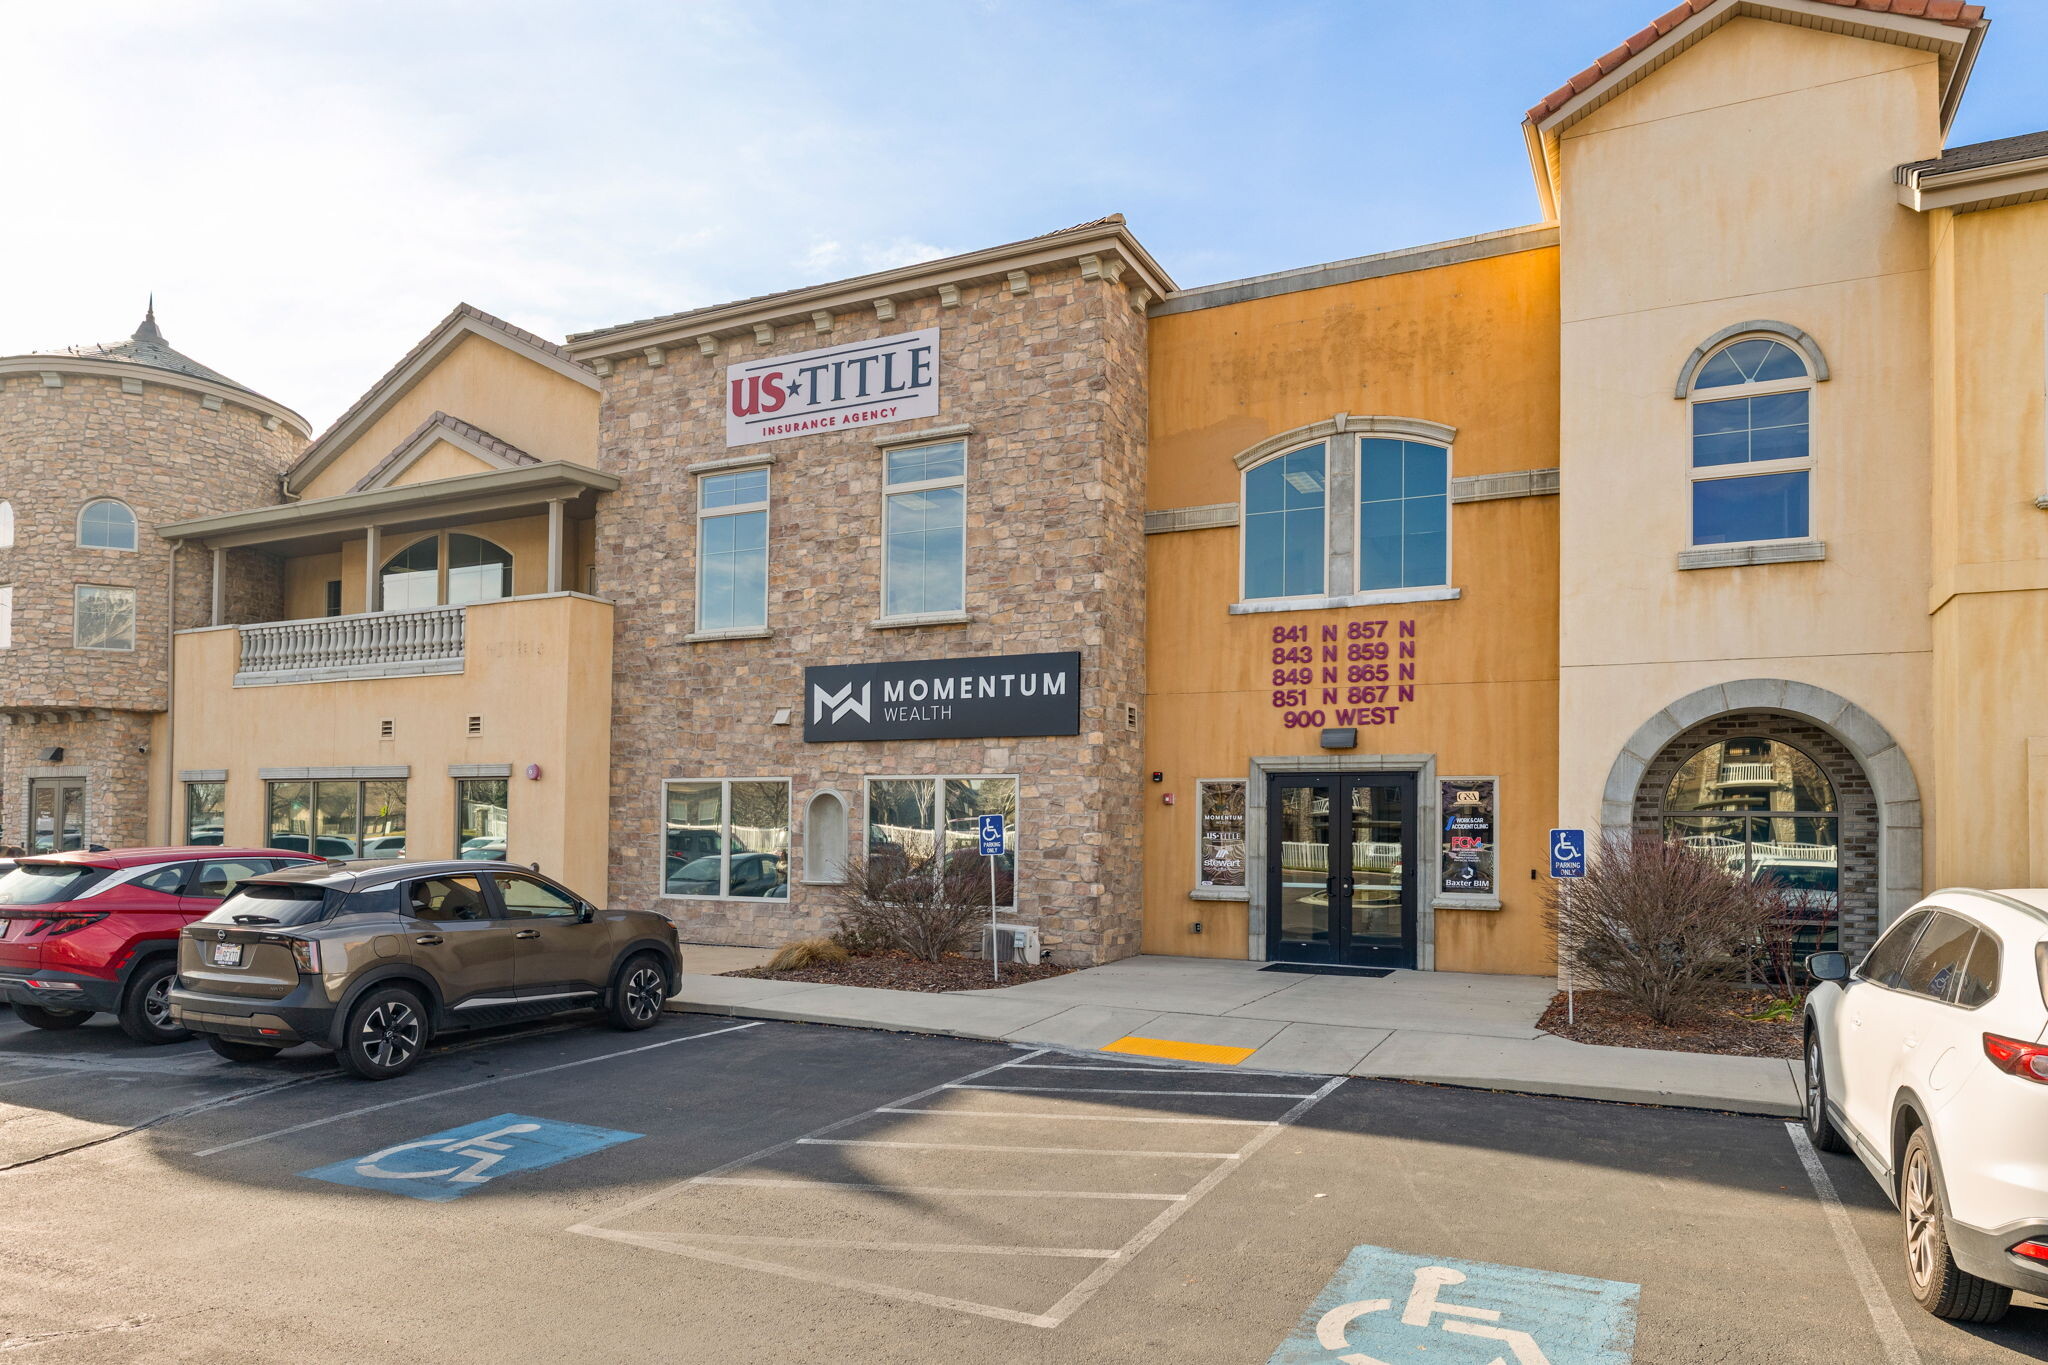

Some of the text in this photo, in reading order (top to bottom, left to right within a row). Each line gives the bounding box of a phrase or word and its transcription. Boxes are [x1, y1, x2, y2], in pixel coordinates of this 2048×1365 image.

[731, 345, 932, 417] US TITLE
[762, 406, 898, 436] INSURANCE AGENCY
[1272, 619, 1415, 643] 841 N 857 N
[1272, 640, 1415, 665] 843 N 859 N
[1272, 662, 1415, 686] 849 N 865 N
[884, 671, 1067, 702] MOMENTUM
[1272, 684, 1414, 708] 851 N 867 N
[884, 705, 952, 722] WEALTH
[1283, 706, 1400, 729] 900 WEST
[1219, 832, 1241, 840] TITLE
[1203, 859, 1241, 867] stewart
[1445, 879, 1472, 887] Baxter
